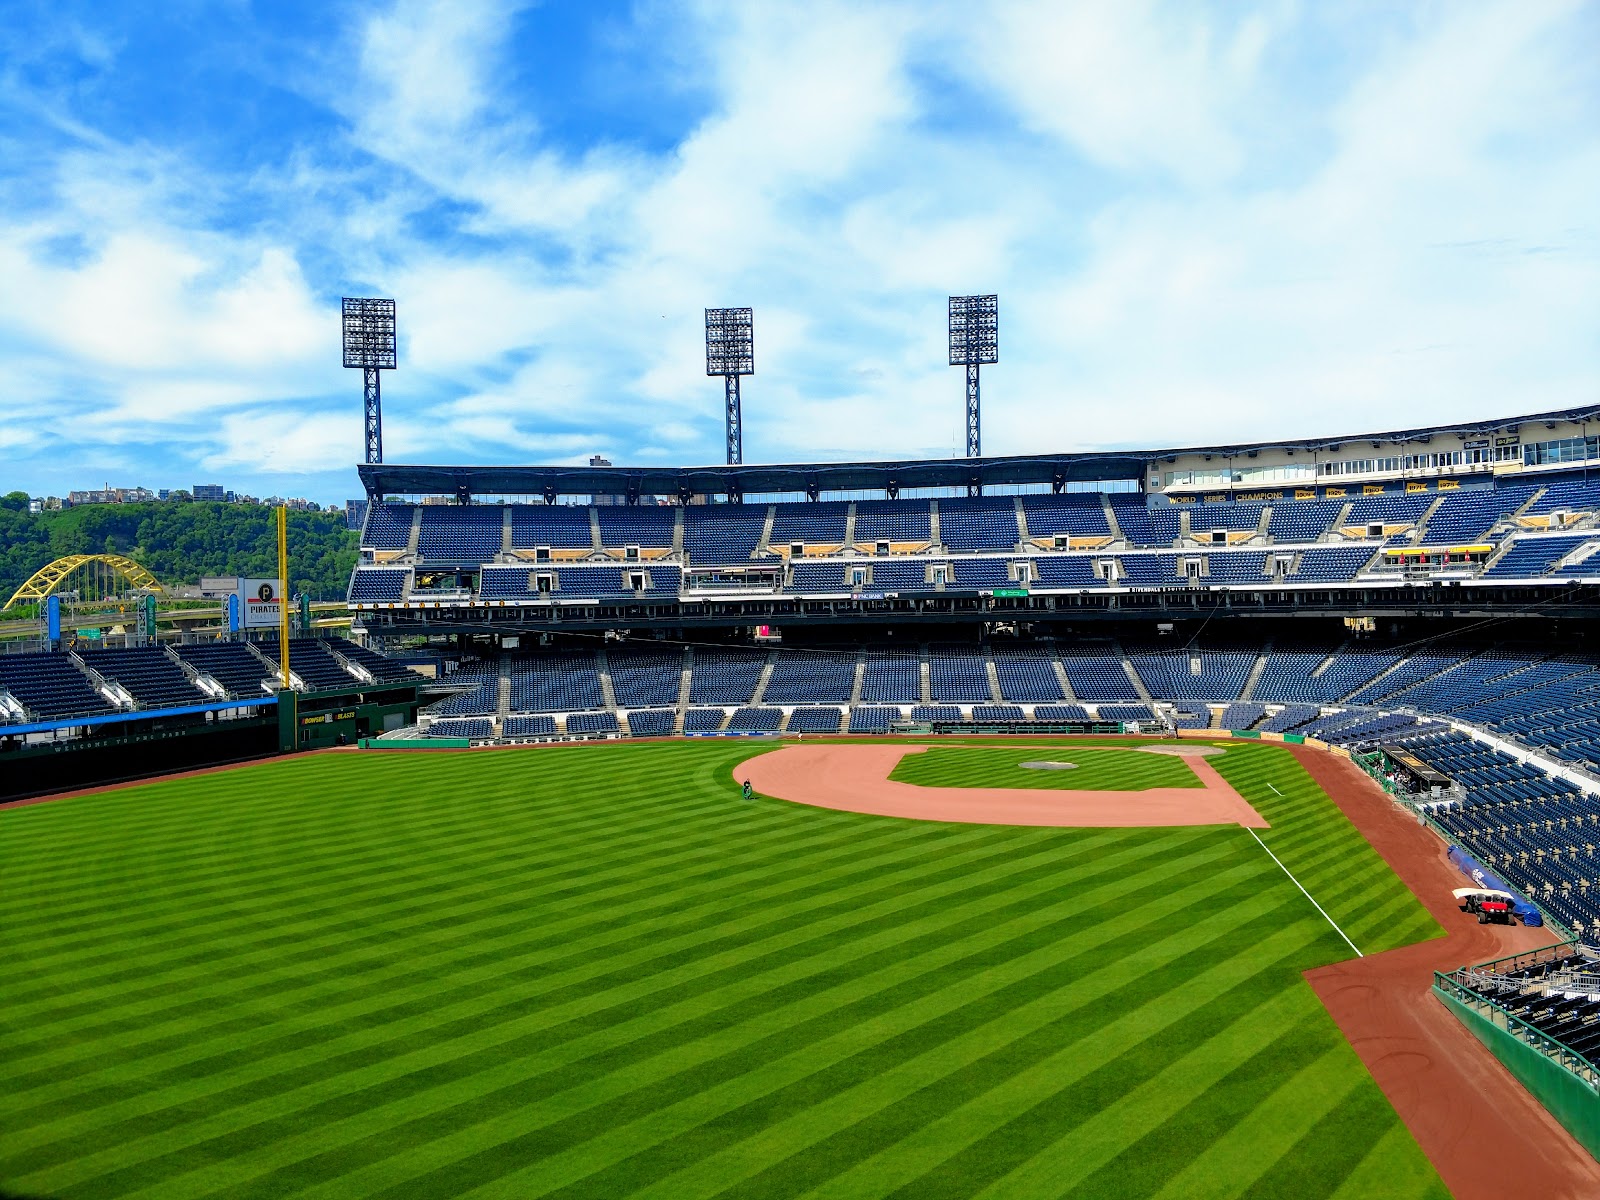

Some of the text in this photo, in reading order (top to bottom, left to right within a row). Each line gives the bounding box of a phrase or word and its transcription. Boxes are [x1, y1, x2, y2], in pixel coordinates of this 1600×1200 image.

[1203, 495, 1227, 503] SERIES
[1236, 491, 1284, 502] CHAMPIONS
[250, 605, 281, 614] PIRATES
[444, 660, 460, 675] Lite
[54, 740, 108, 753] WELCOME
